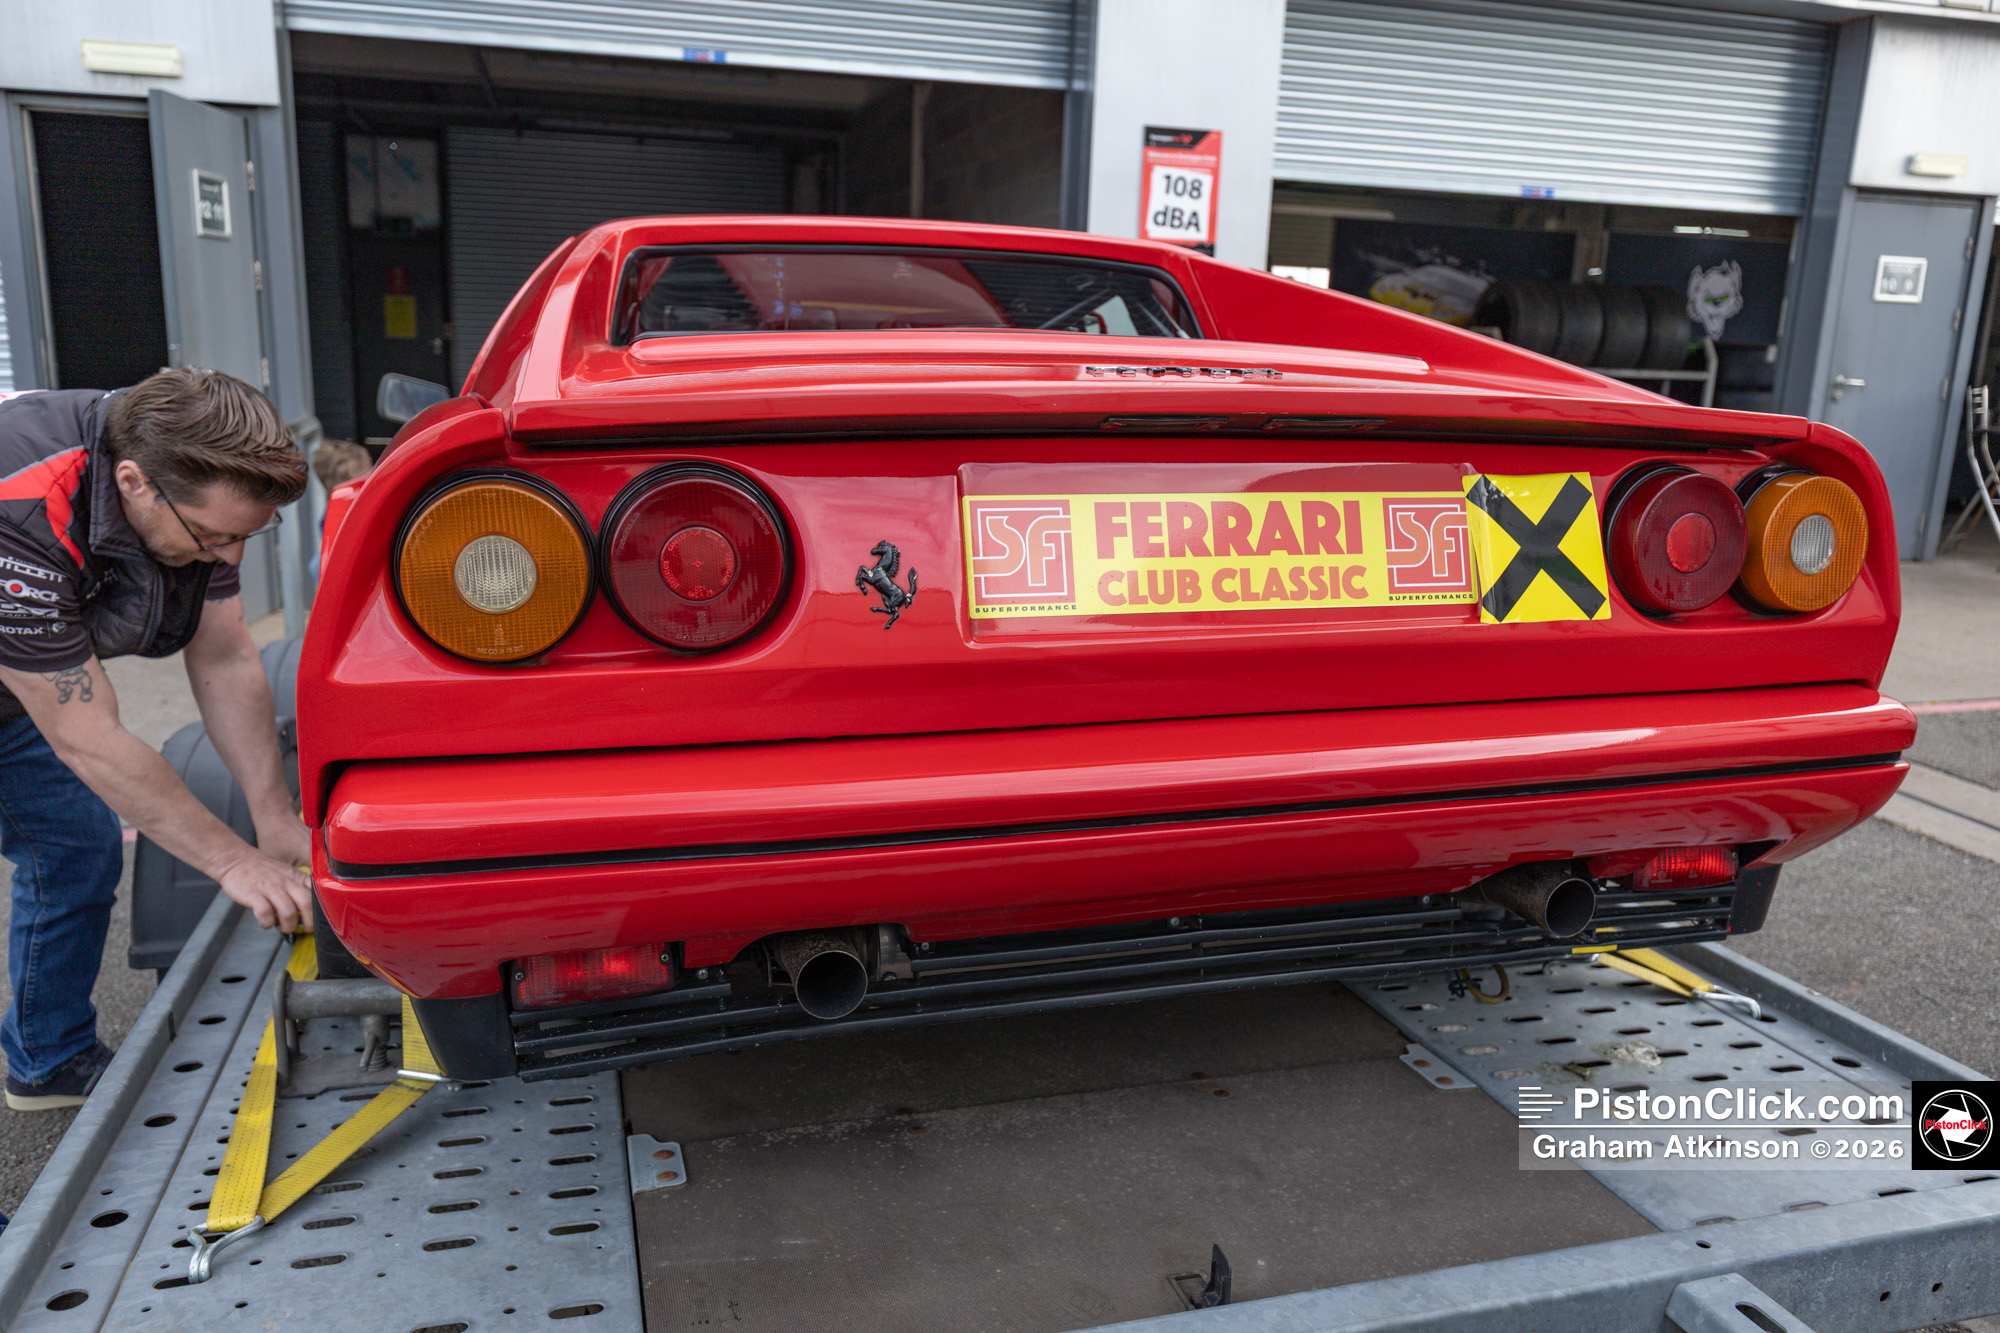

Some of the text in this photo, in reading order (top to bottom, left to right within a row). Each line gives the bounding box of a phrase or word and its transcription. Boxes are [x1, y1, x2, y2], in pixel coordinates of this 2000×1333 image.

[1164, 174, 1203, 200] 108
[1153, 205, 1201, 233] dBA
[1093, 500, 1364, 559] FERRARI
[1097, 565, 1370, 607] CLUB CLASSIC
[1388, 593, 1474, 602] SUPERFORMANCE
[974, 604, 1077, 614] SUPERFORMANCE
